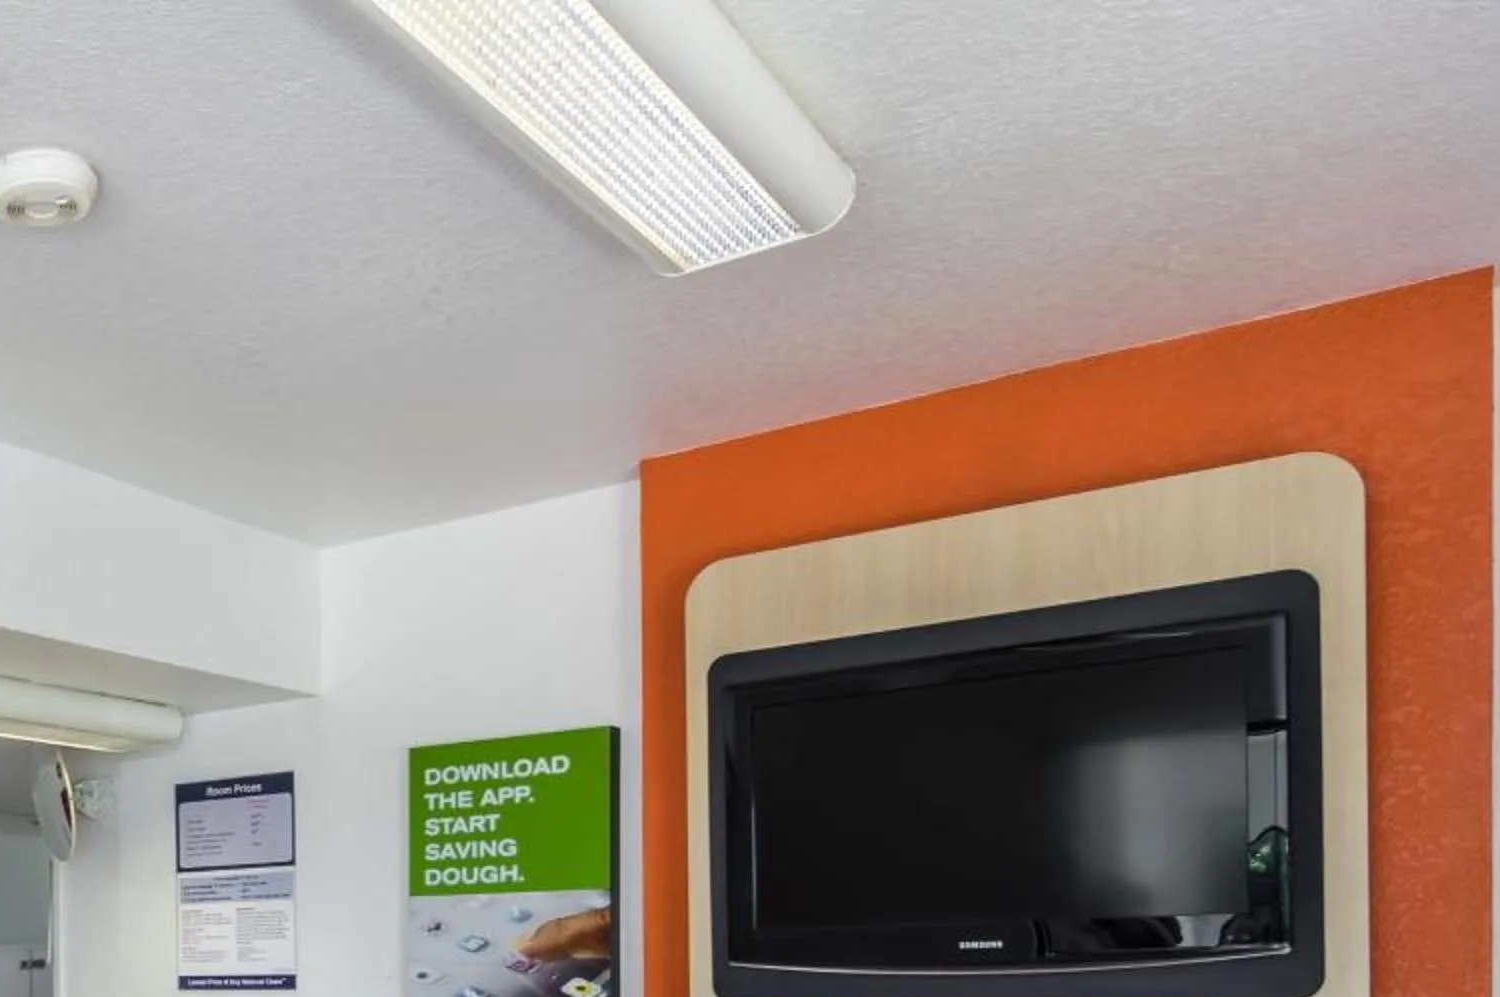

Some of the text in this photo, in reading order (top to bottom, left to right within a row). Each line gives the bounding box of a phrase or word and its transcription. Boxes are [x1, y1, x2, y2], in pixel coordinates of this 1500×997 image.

[424, 755, 571, 786] DOWNLOAD
[424, 785, 535, 811] THE APP.
[424, 813, 500, 836] START
[424, 838, 517, 861] SAVING
[424, 864, 525, 886] DOUGH.
